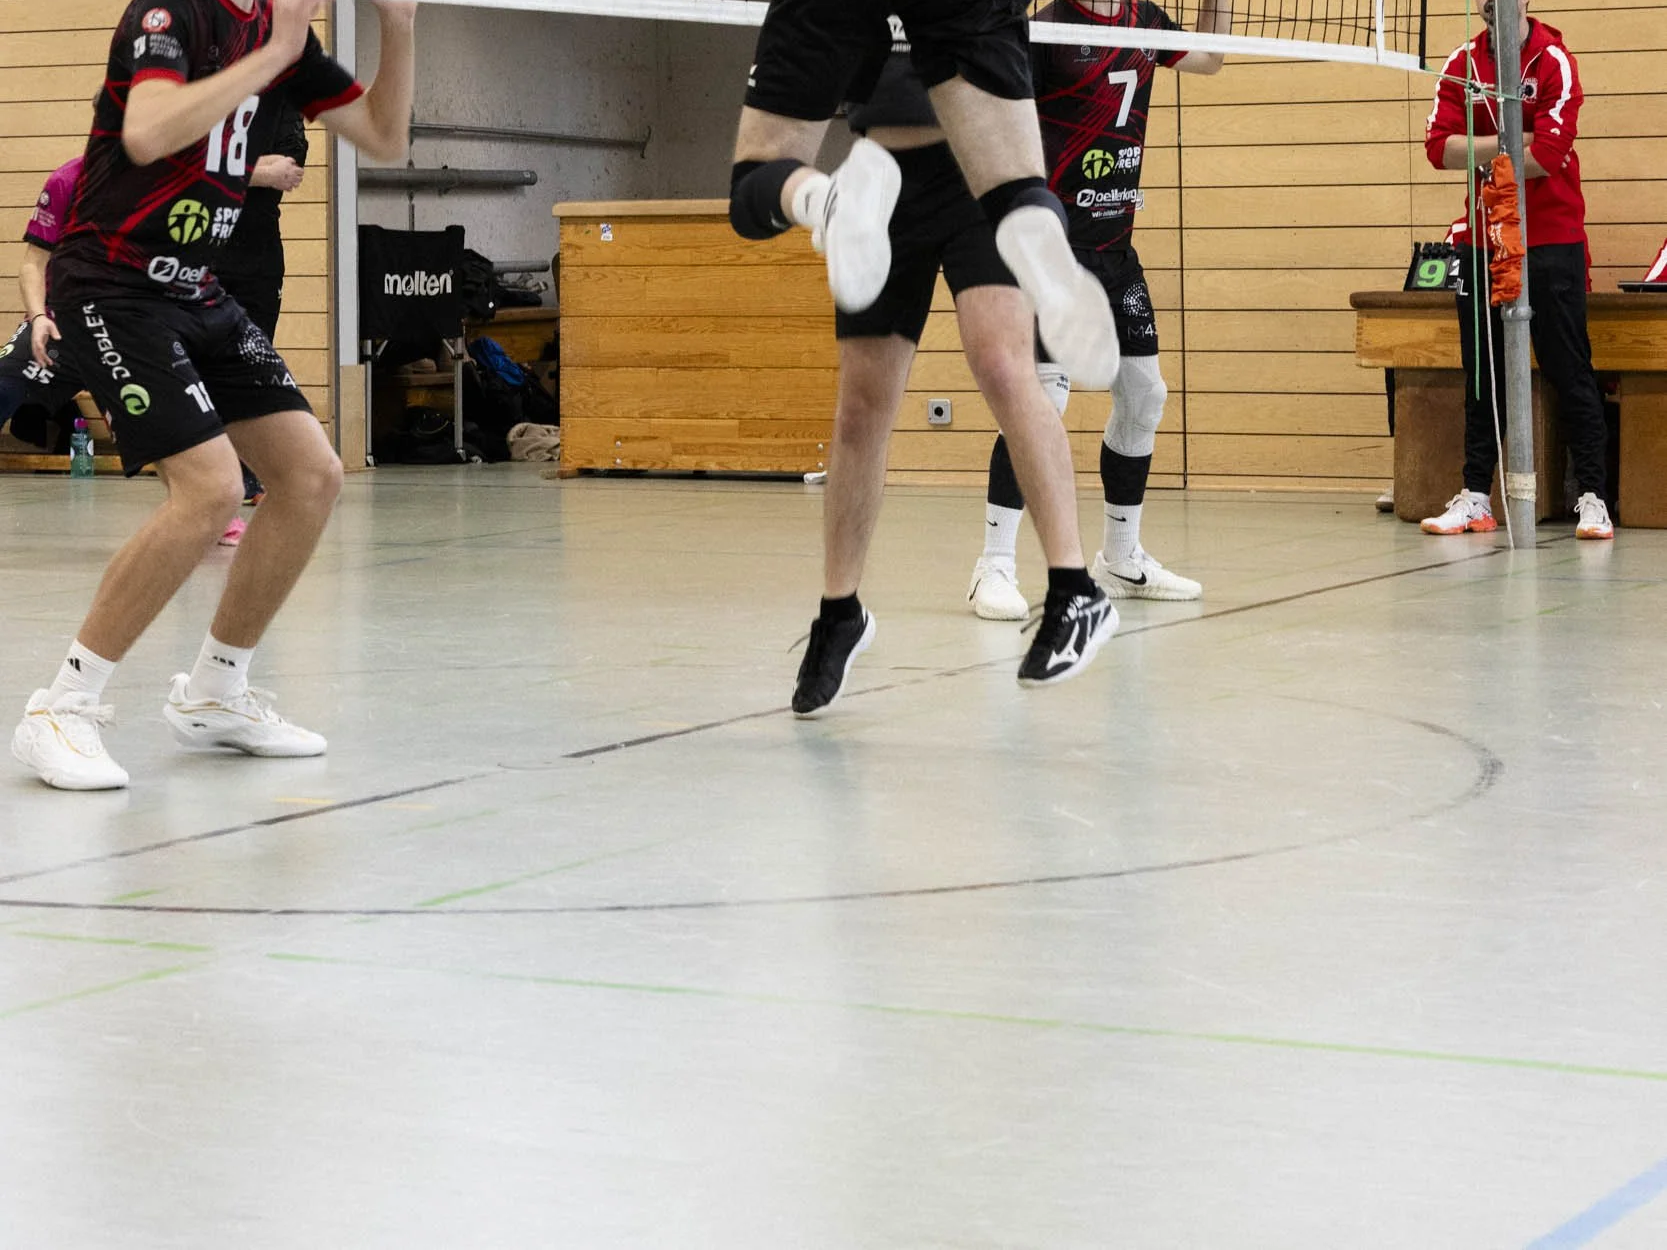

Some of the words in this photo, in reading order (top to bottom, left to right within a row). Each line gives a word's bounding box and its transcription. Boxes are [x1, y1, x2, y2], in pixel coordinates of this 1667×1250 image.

[1108, 69, 1138, 128] 7
[205, 94, 260, 177] 18
[213, 206, 243, 224] SPO
[384, 270, 453, 296] molten
[1416, 259, 1447, 288] 9
[1127, 323, 1158, 340] M4
[22, 360, 55, 384] 35
